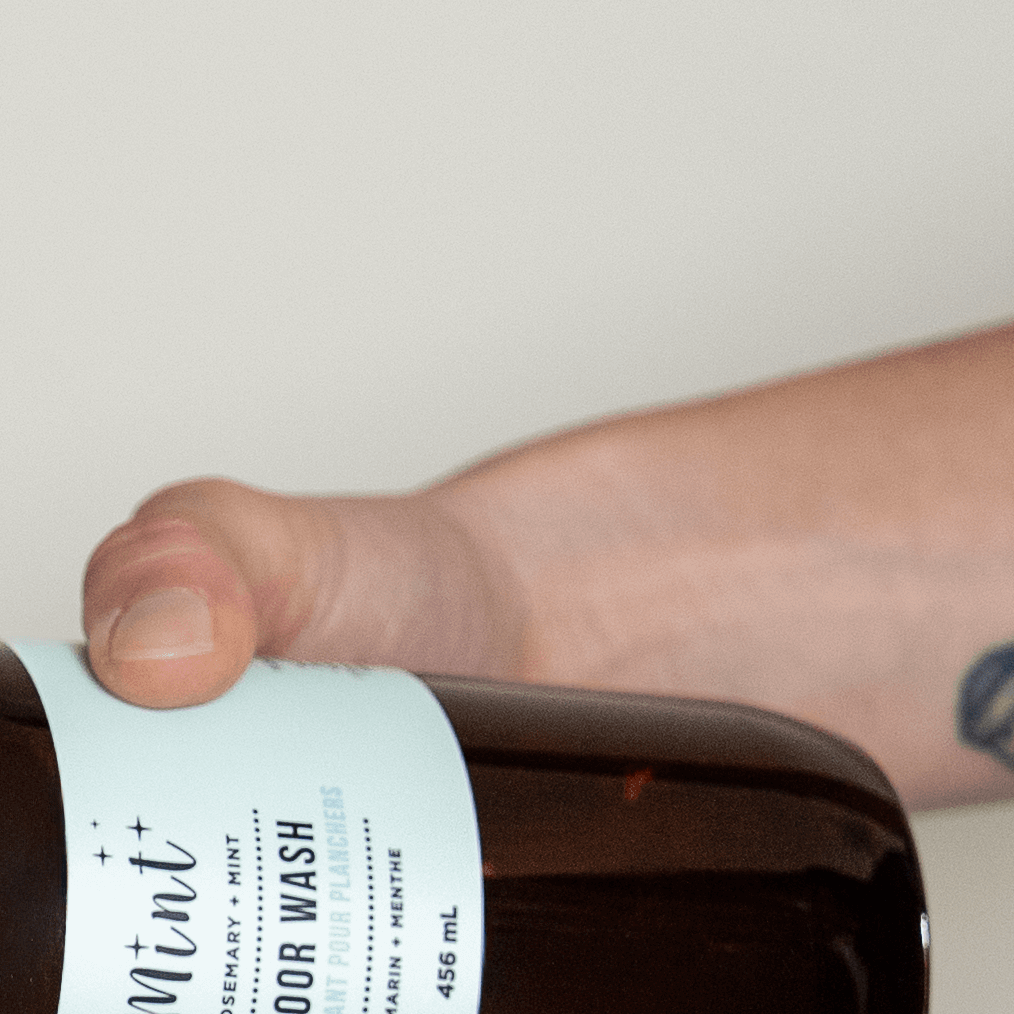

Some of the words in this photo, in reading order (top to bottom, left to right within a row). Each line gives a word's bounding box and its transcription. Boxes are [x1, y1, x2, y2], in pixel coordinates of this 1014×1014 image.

[225, 834, 242, 885] MINT
[320, 786, 350, 902] PLANCHERS
[276, 820, 318, 923] WASH
[388, 847, 403, 929] MENTHE
[229, 896, 240, 907] +
[439, 906, 458, 943] mL
[324, 911, 351, 967] POUR
[391, 937, 401, 948] +
[436, 952, 457, 1000] 456
